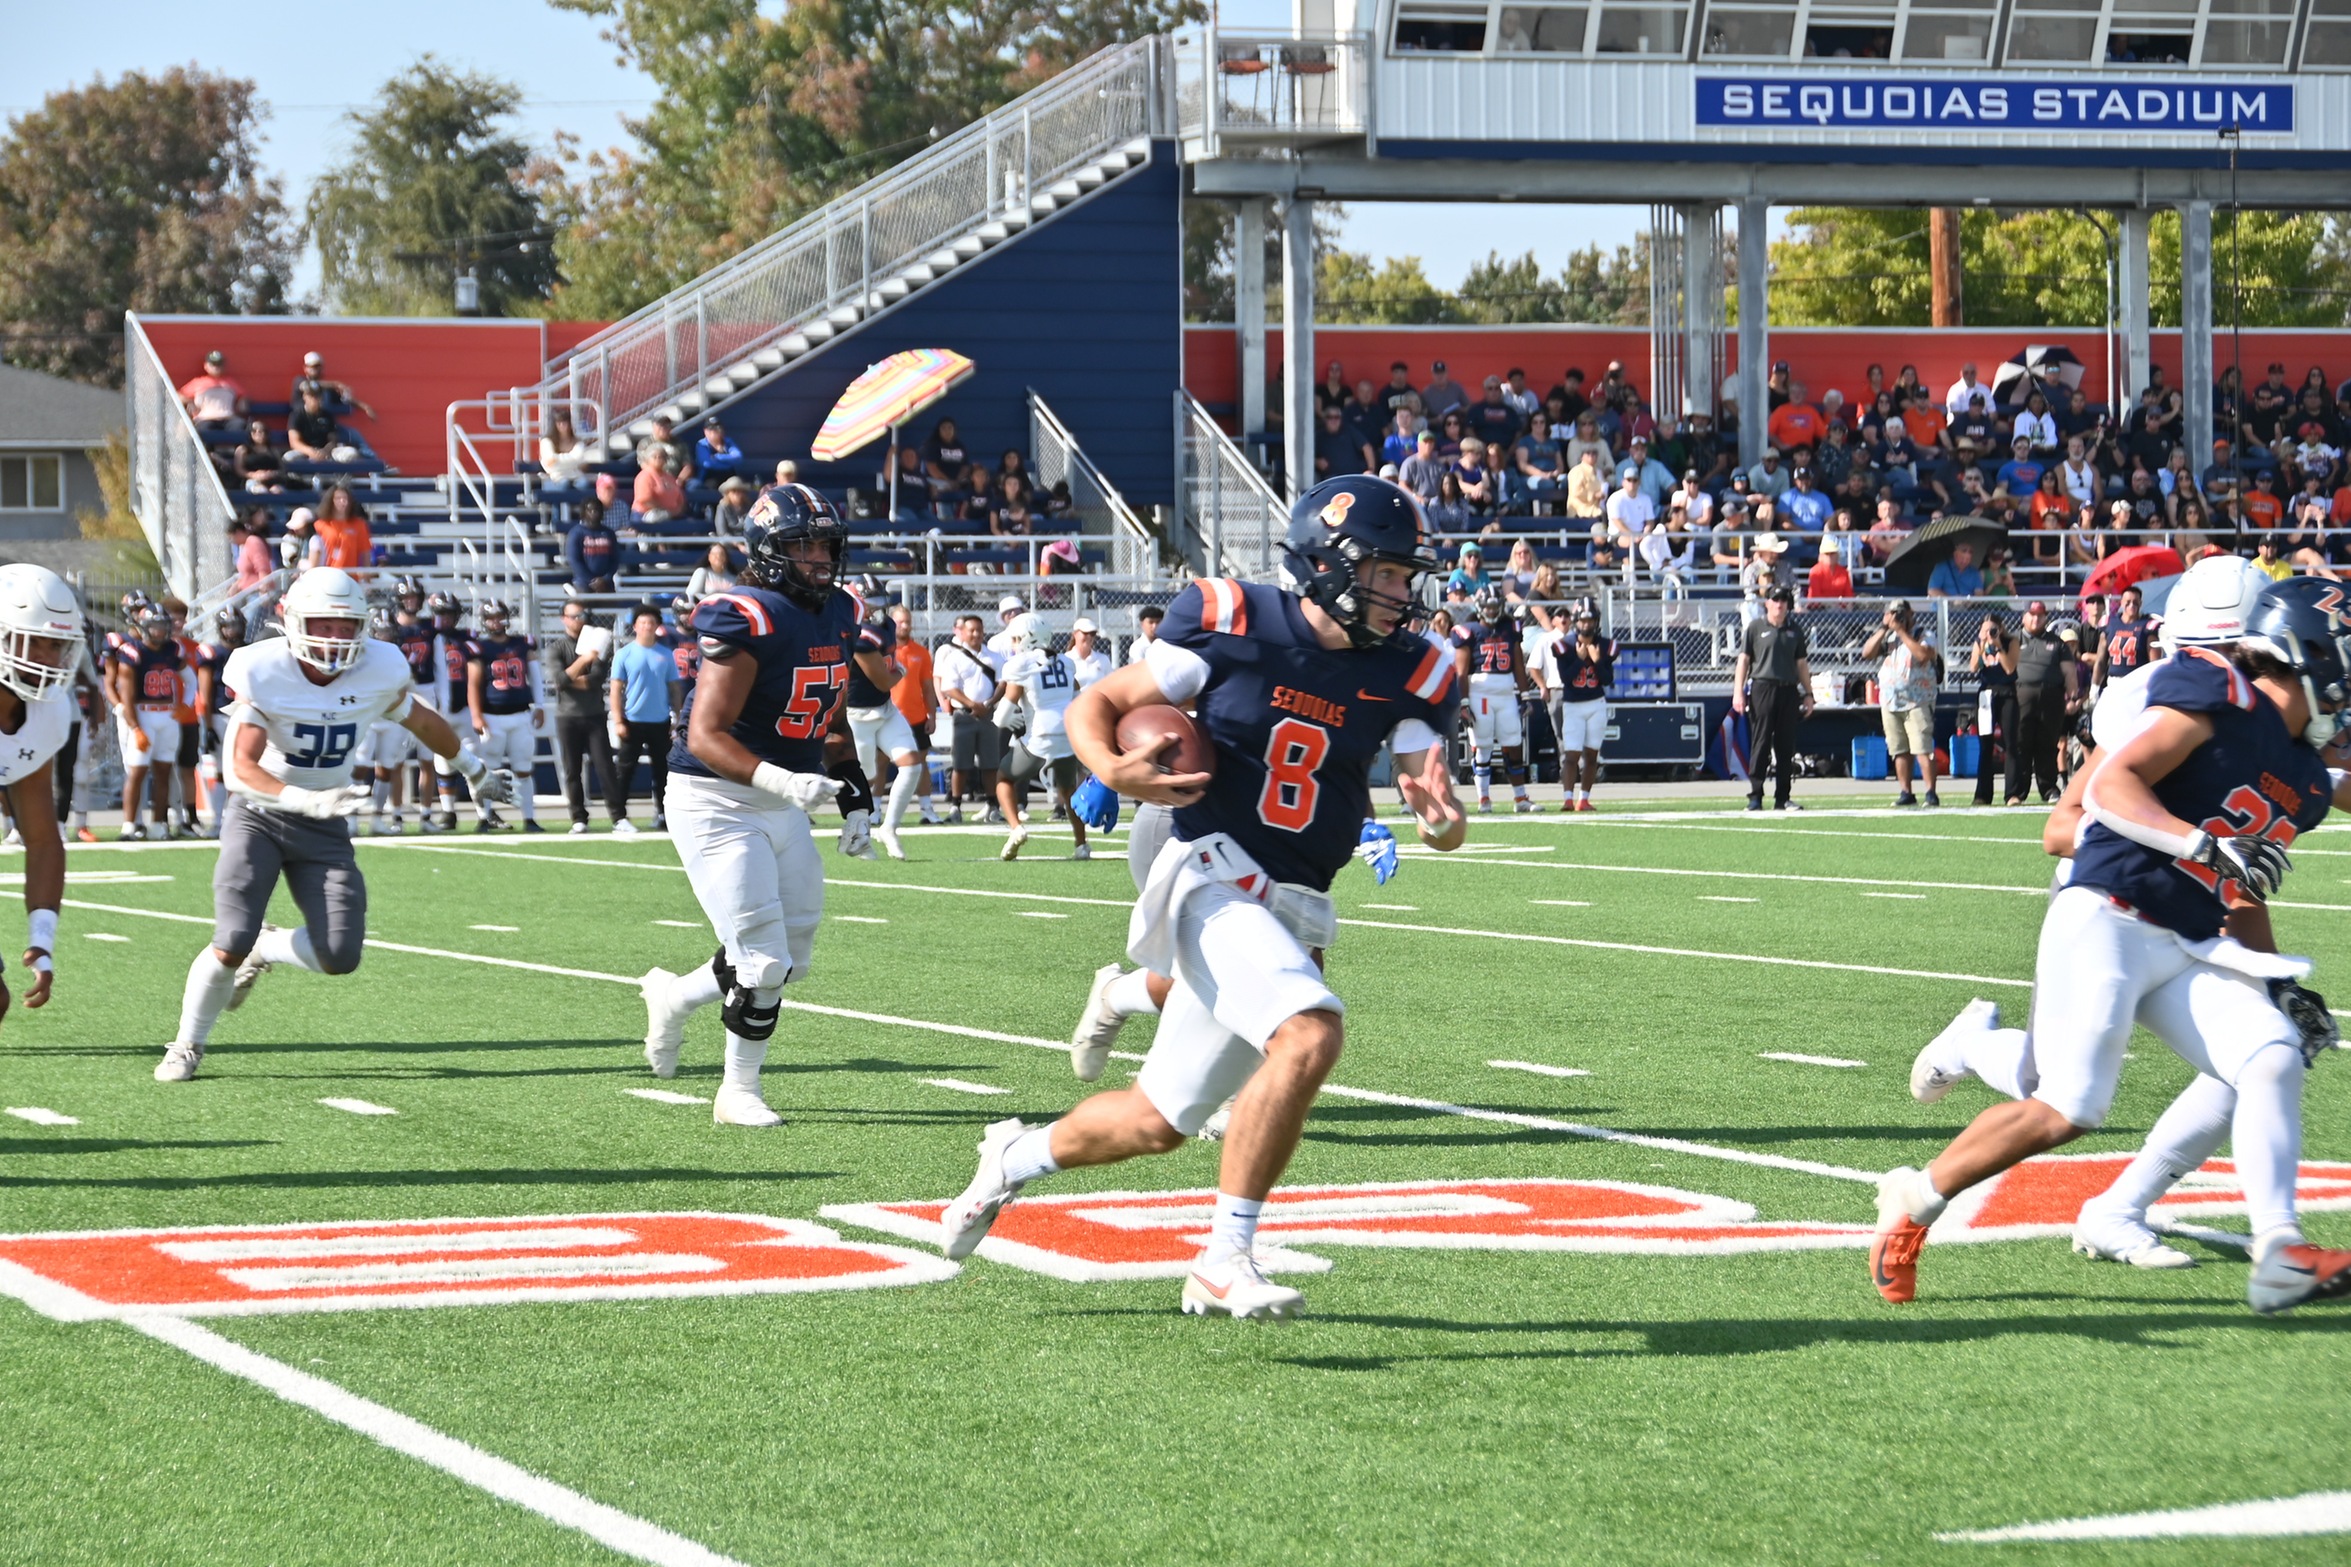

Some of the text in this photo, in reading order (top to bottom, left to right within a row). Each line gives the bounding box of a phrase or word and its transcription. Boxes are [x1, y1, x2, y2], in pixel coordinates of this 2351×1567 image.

[1723, 85, 2267, 124] SEQUOIAS STADIUM
[1320, 492, 1356, 527] 8
[1480, 642, 1511, 672] 75
[2108, 635, 2137, 666] 44
[491, 658, 523, 691] 93
[1040, 659, 1069, 690] 28
[775, 661, 849, 740] 57
[1270, 685, 1348, 728] SEQUOIAS
[285, 722, 357, 768] 39
[1257, 717, 1331, 833] 8
